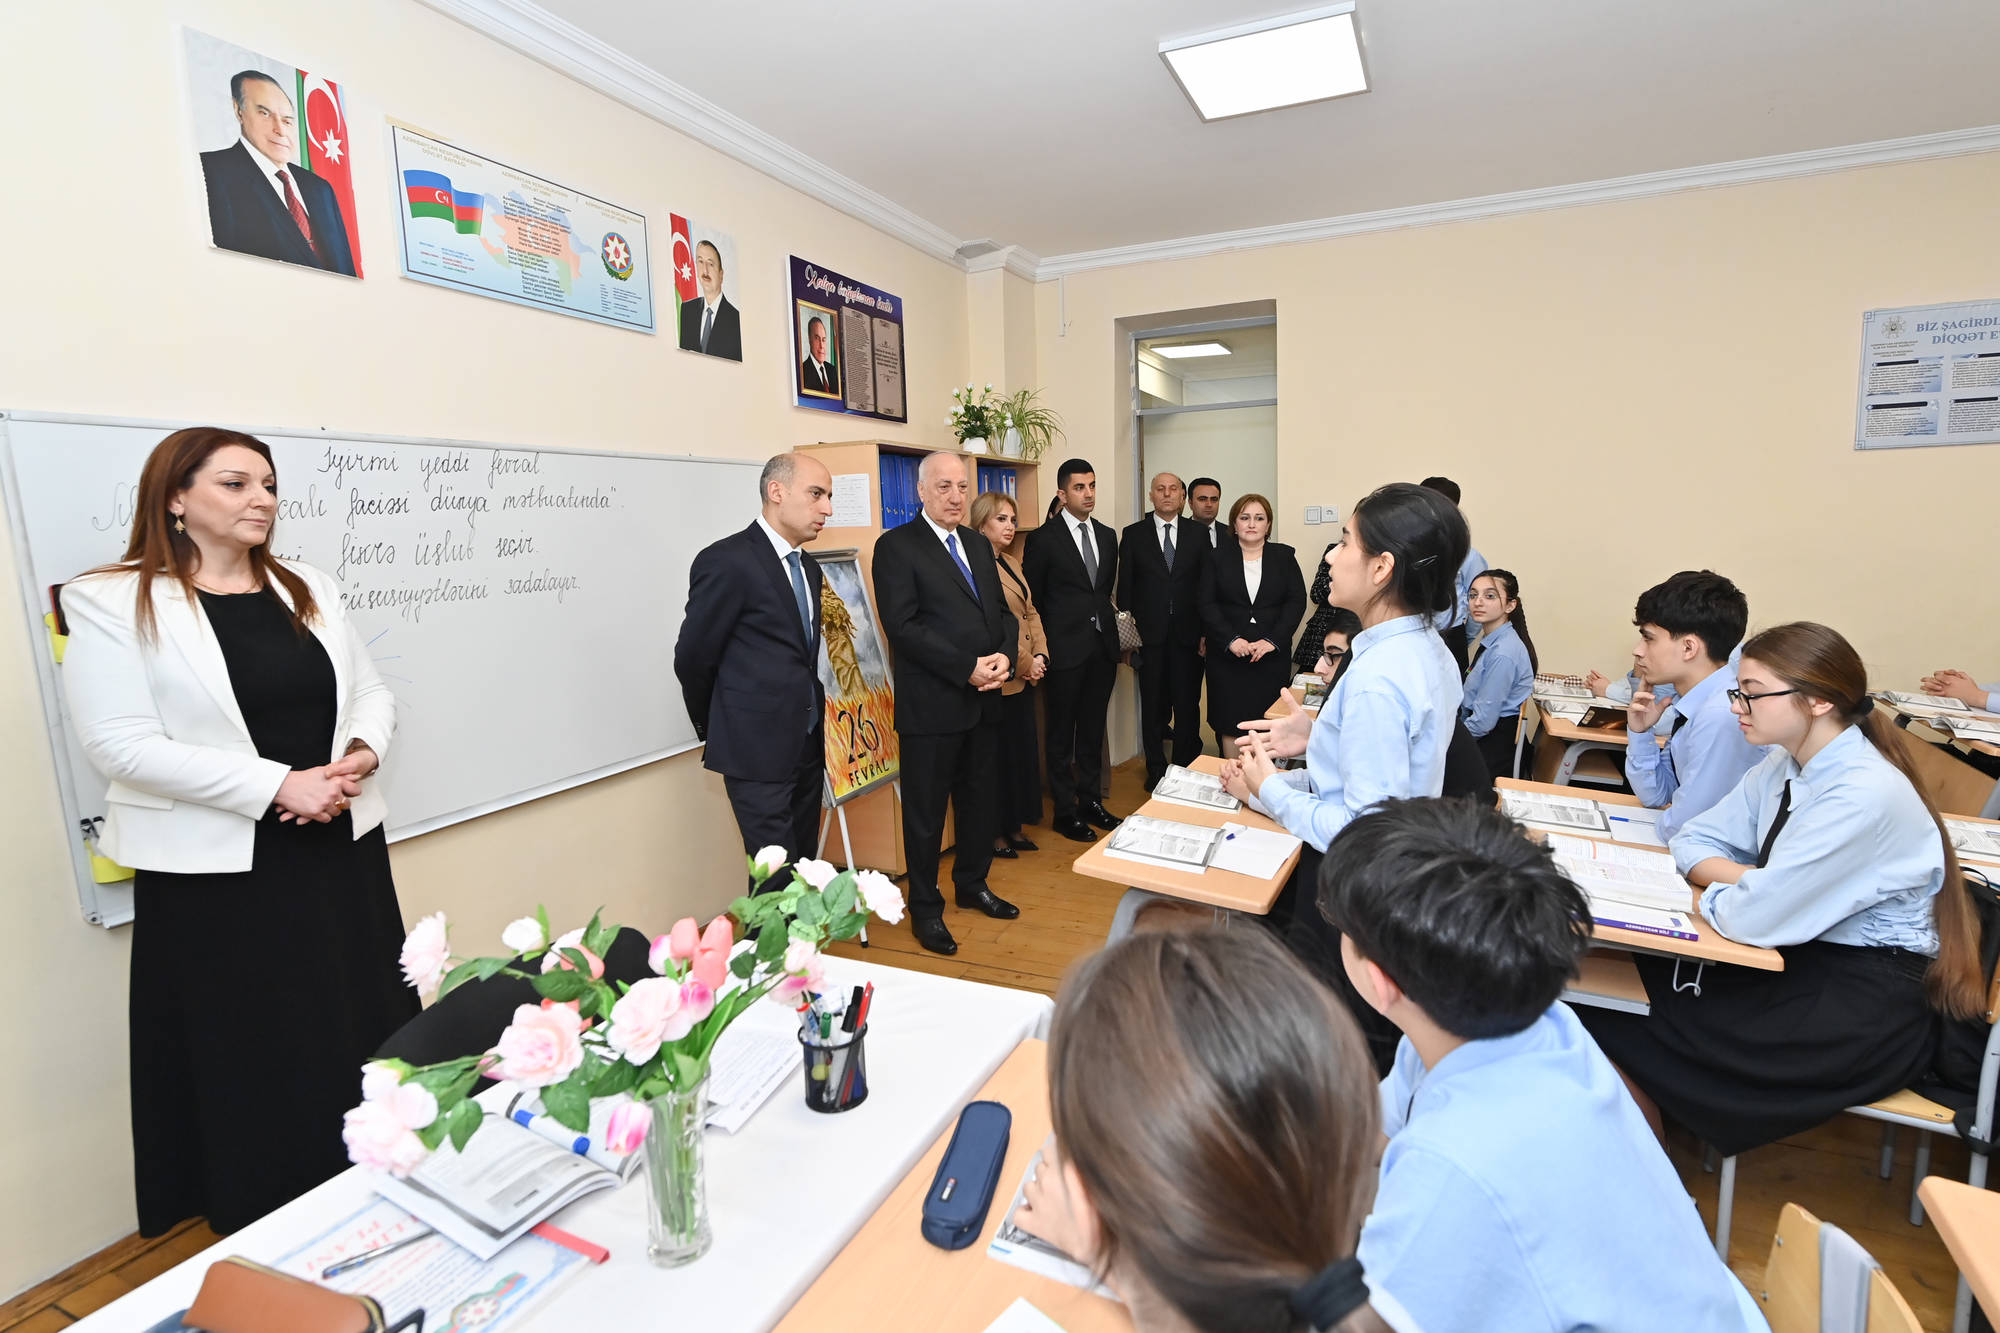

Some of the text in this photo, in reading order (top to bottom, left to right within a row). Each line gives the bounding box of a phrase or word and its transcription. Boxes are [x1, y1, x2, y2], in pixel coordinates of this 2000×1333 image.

[1916, 320, 1938, 332] BİZ
[1932, 331, 1986, 345] DİQQƏT
[420, 450, 469, 493] yeddi
[277, 483, 328, 521] calı
[430, 484, 490, 529] dünya
[838, 704, 880, 764] 26
[848, 758, 890, 788] FEVRAL
